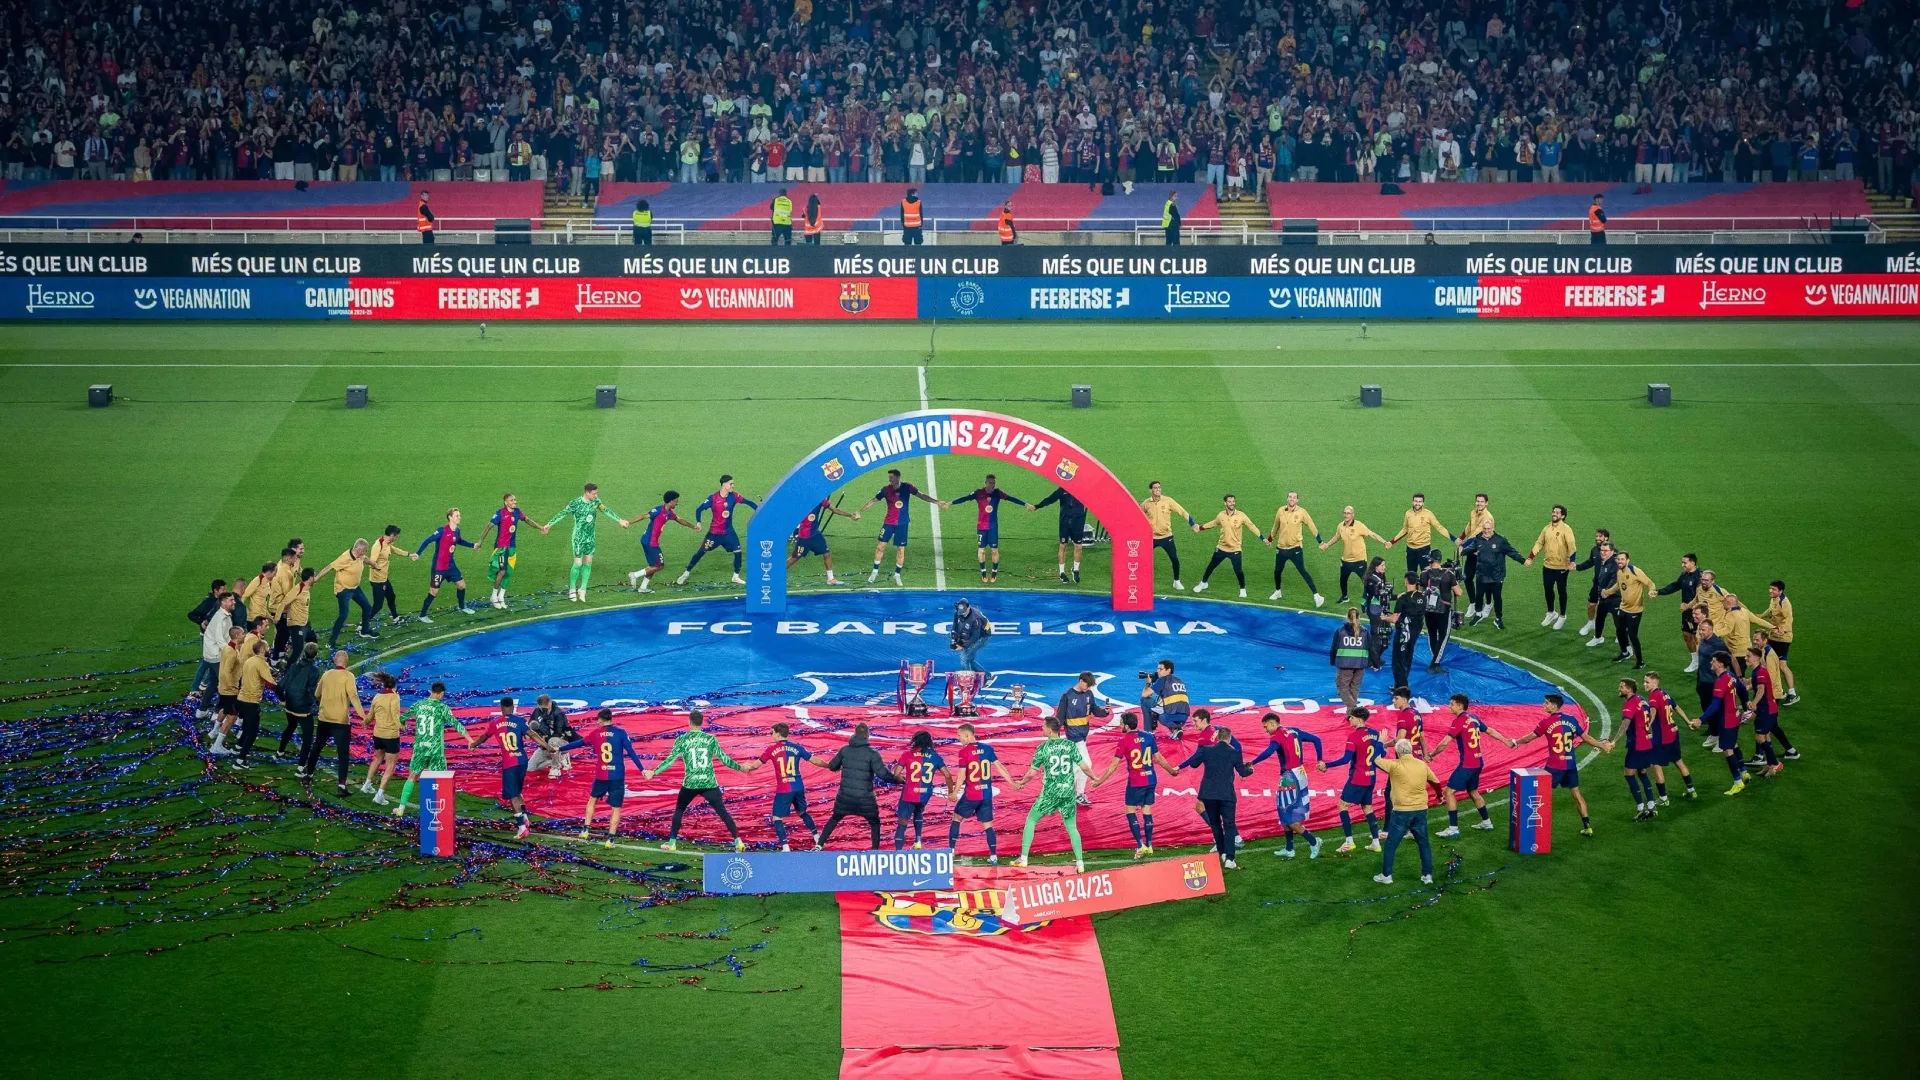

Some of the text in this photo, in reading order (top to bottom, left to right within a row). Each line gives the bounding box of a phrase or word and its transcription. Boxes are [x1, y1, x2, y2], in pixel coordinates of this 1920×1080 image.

[23, 256, 60, 275] QUE
[66, 257, 94, 272] UN
[98, 257, 147, 272] CLUB
[192, 253, 361, 276] MÉS QUE UN CLUB
[413, 253, 581, 276] MÉS QUE UN CLUB
[624, 254, 791, 277] MÉS QUE UN CLUB
[834, 254, 1000, 277] MÉS QUE UN CLUB
[1043, 254, 1208, 277] MÉS QUE UN CLUB
[1251, 254, 1416, 276] MÉS QUE UN CLUB
[1467, 253, 1633, 276] MÉS QUE UN CLUB
[1676, 253, 1843, 275] MÉS QUE UN CLUB
[161, 289, 250, 309] VEGANNATION
[305, 288, 395, 308] CAMPIONS
[439, 288, 522, 309] FEEBERSE
[705, 289, 794, 309] VEGANNATION
[1031, 288, 1112, 309] FEEBERSE
[1293, 288, 1382, 309] VEGANNATION
[1435, 286, 1522, 306] CAMPIONS
[1565, 286, 1647, 307] FEEBERSE
[1831, 285, 1919, 305] VEGANNATION
[850, 420, 1052, 467] CAMPIONS 24/25
[667, 621, 753, 635] FC
[1343, 636, 1362, 647] 003
[417, 714, 434, 737] 31
[499, 731, 518, 752] 10
[1294, 738, 1302, 759] 4
[1552, 731, 1573, 754] 35
[600, 742, 613, 764] 8
[688, 747, 709, 769] 13
[1130, 746, 1152, 770] 24
[1366, 744, 1375, 767] 2
[777, 756, 796, 778] 14
[910, 761, 934, 784] 23
[968, 759, 991, 783] 20
[1049, 755, 1071, 776] 25
[836, 852, 931, 877] CAMPIONS
[1020, 880, 1064, 909] LLIGA
[1066, 874, 1113, 902] 24/25
